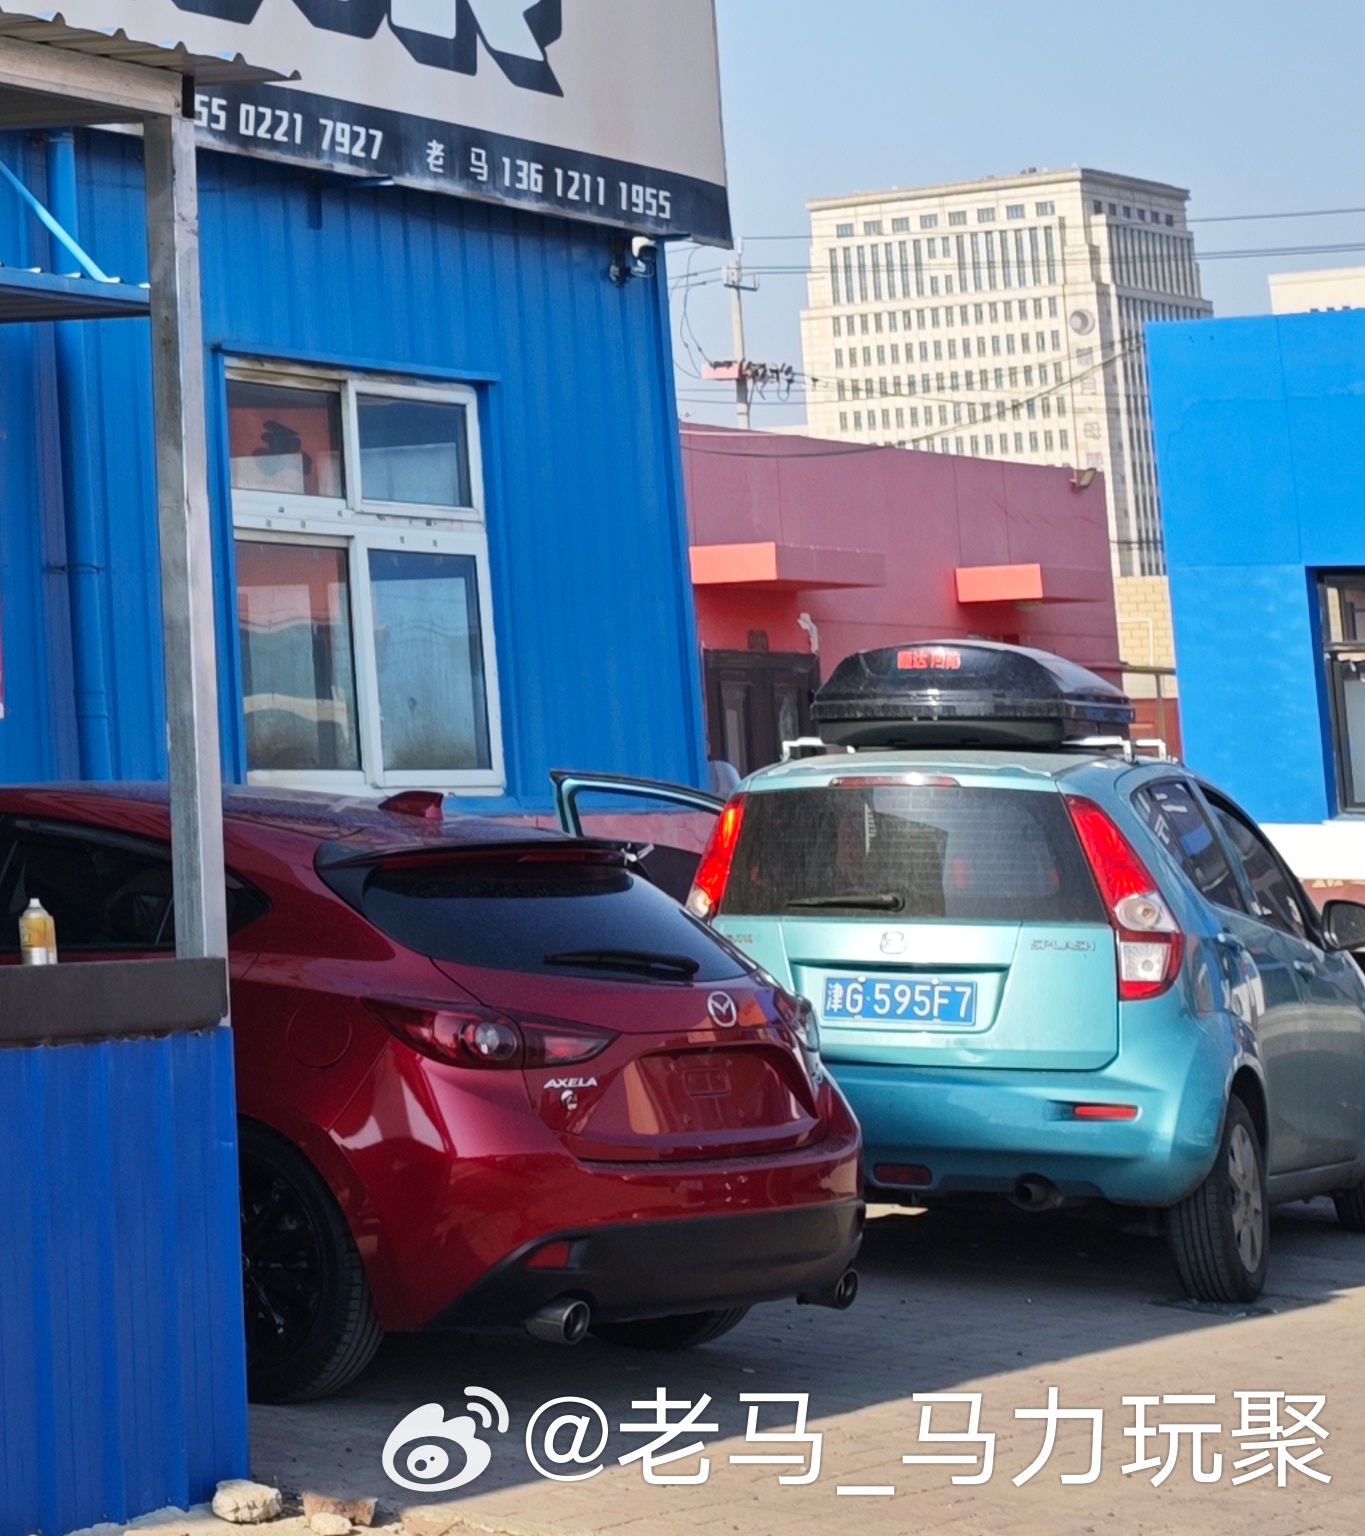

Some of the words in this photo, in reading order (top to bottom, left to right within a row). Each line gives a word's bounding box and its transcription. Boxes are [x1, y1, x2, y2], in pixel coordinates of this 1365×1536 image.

[238, 103, 303, 145] 0221
[319, 117, 383, 160] 7927
[501, 155, 544, 193] 136
[554, 166, 606, 206] 1211
[619, 181, 672, 220] 1955
[543, 1076, 598, 1089] AXELA
